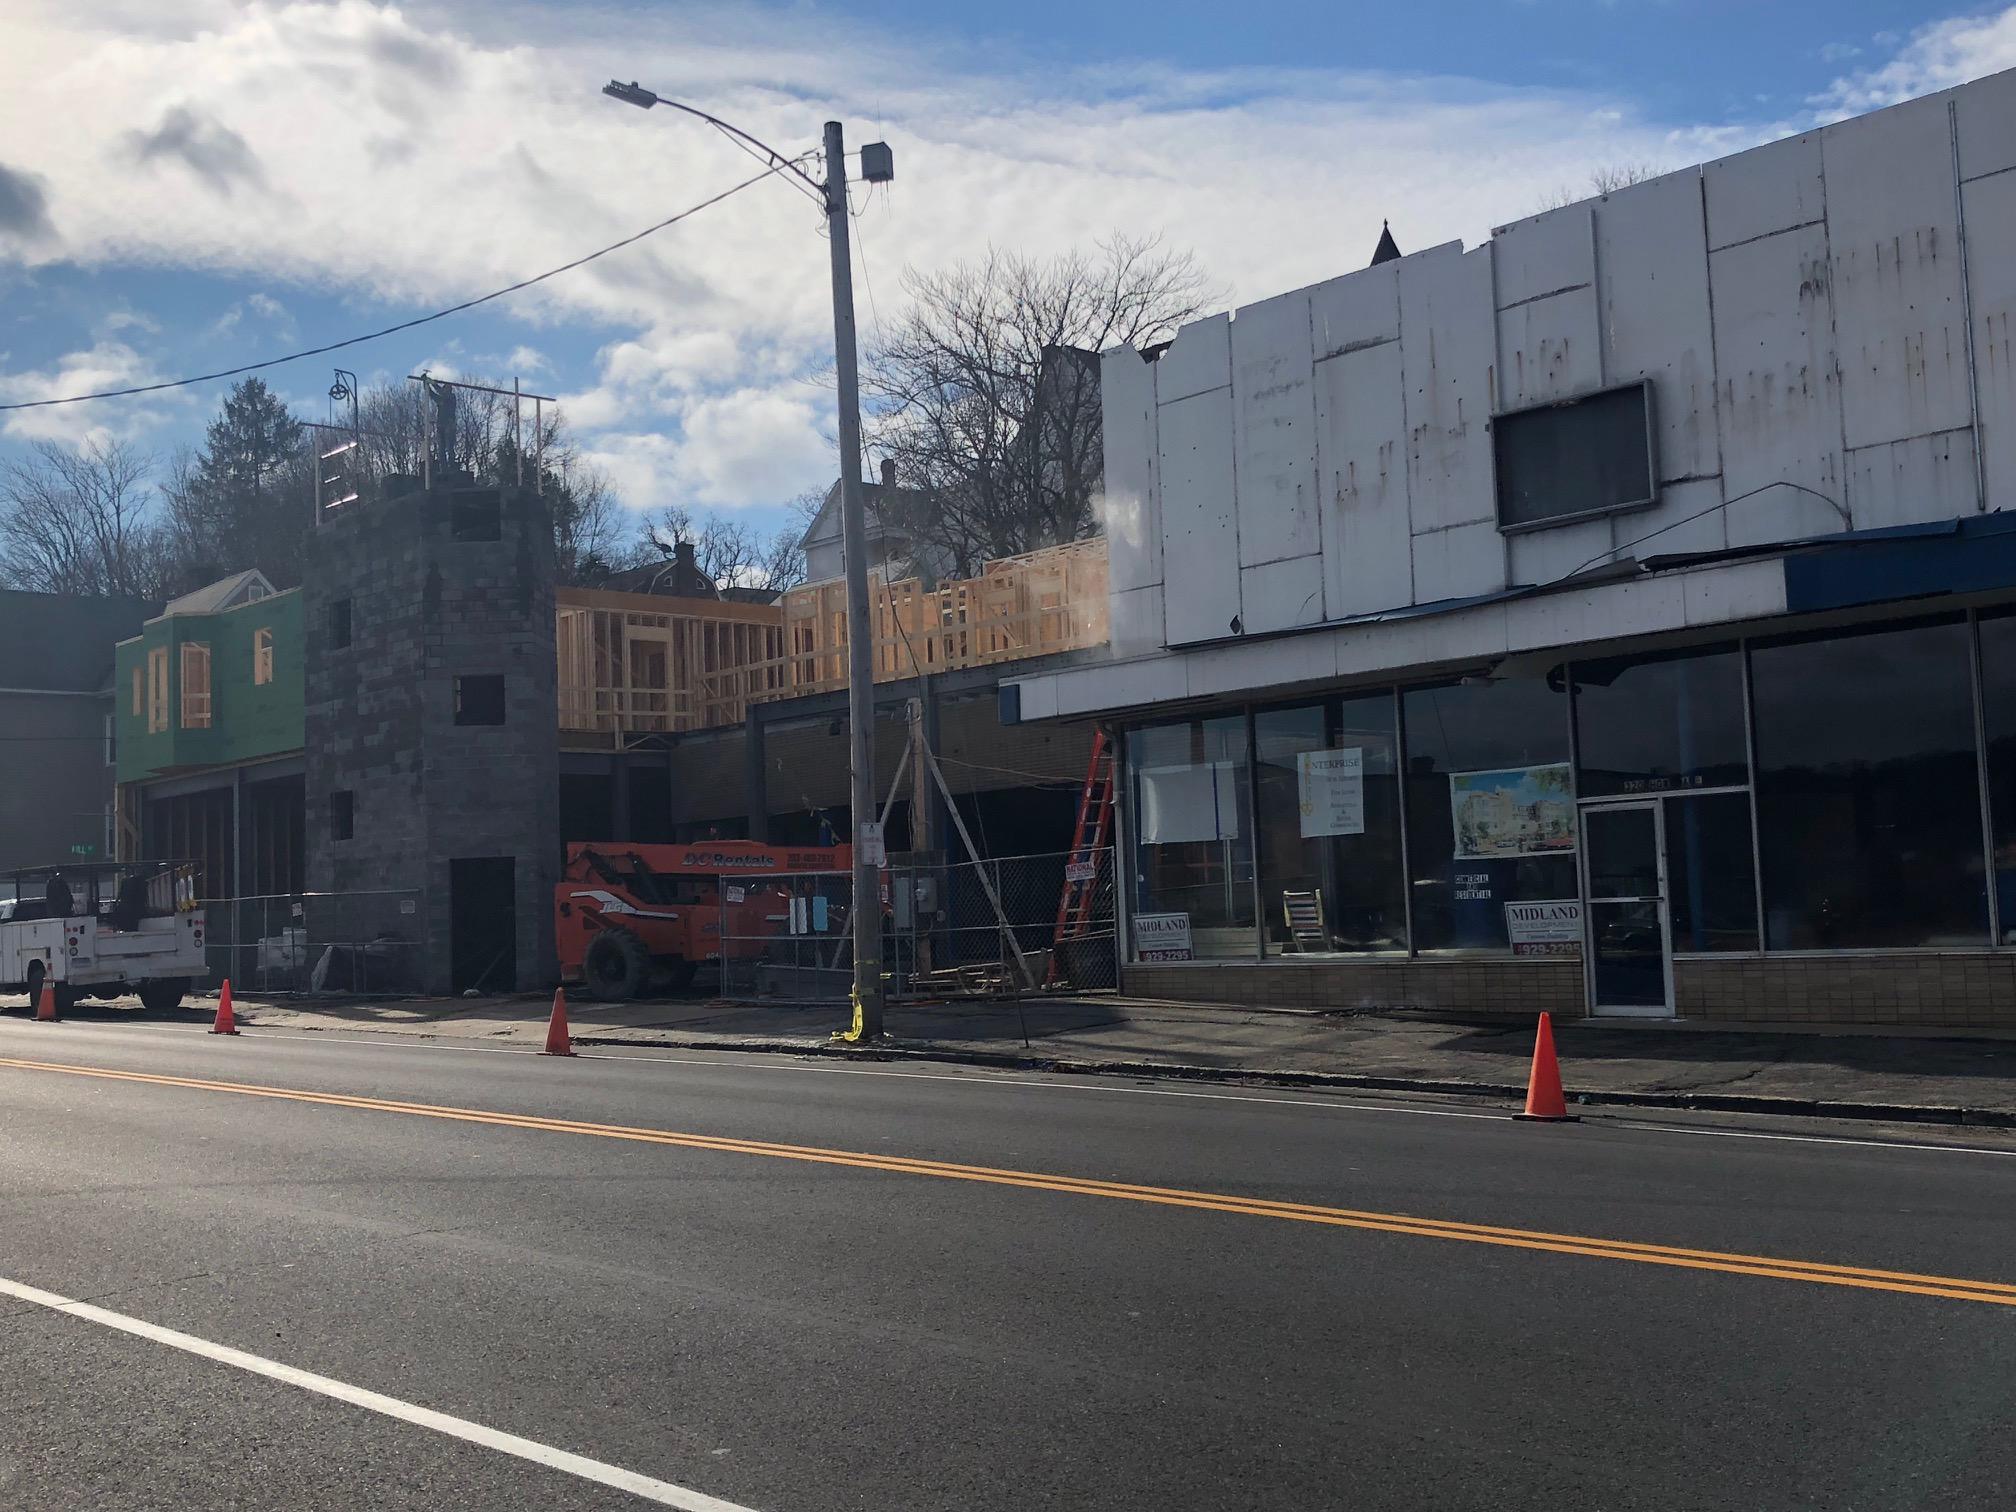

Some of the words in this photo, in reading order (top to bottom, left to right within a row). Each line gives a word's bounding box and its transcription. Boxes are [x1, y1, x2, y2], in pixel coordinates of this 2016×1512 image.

[712, 854, 775, 867] Rentals
[1512, 906, 1578, 920] MIDLAND
[1137, 919, 1186, 932] MIDLAND
